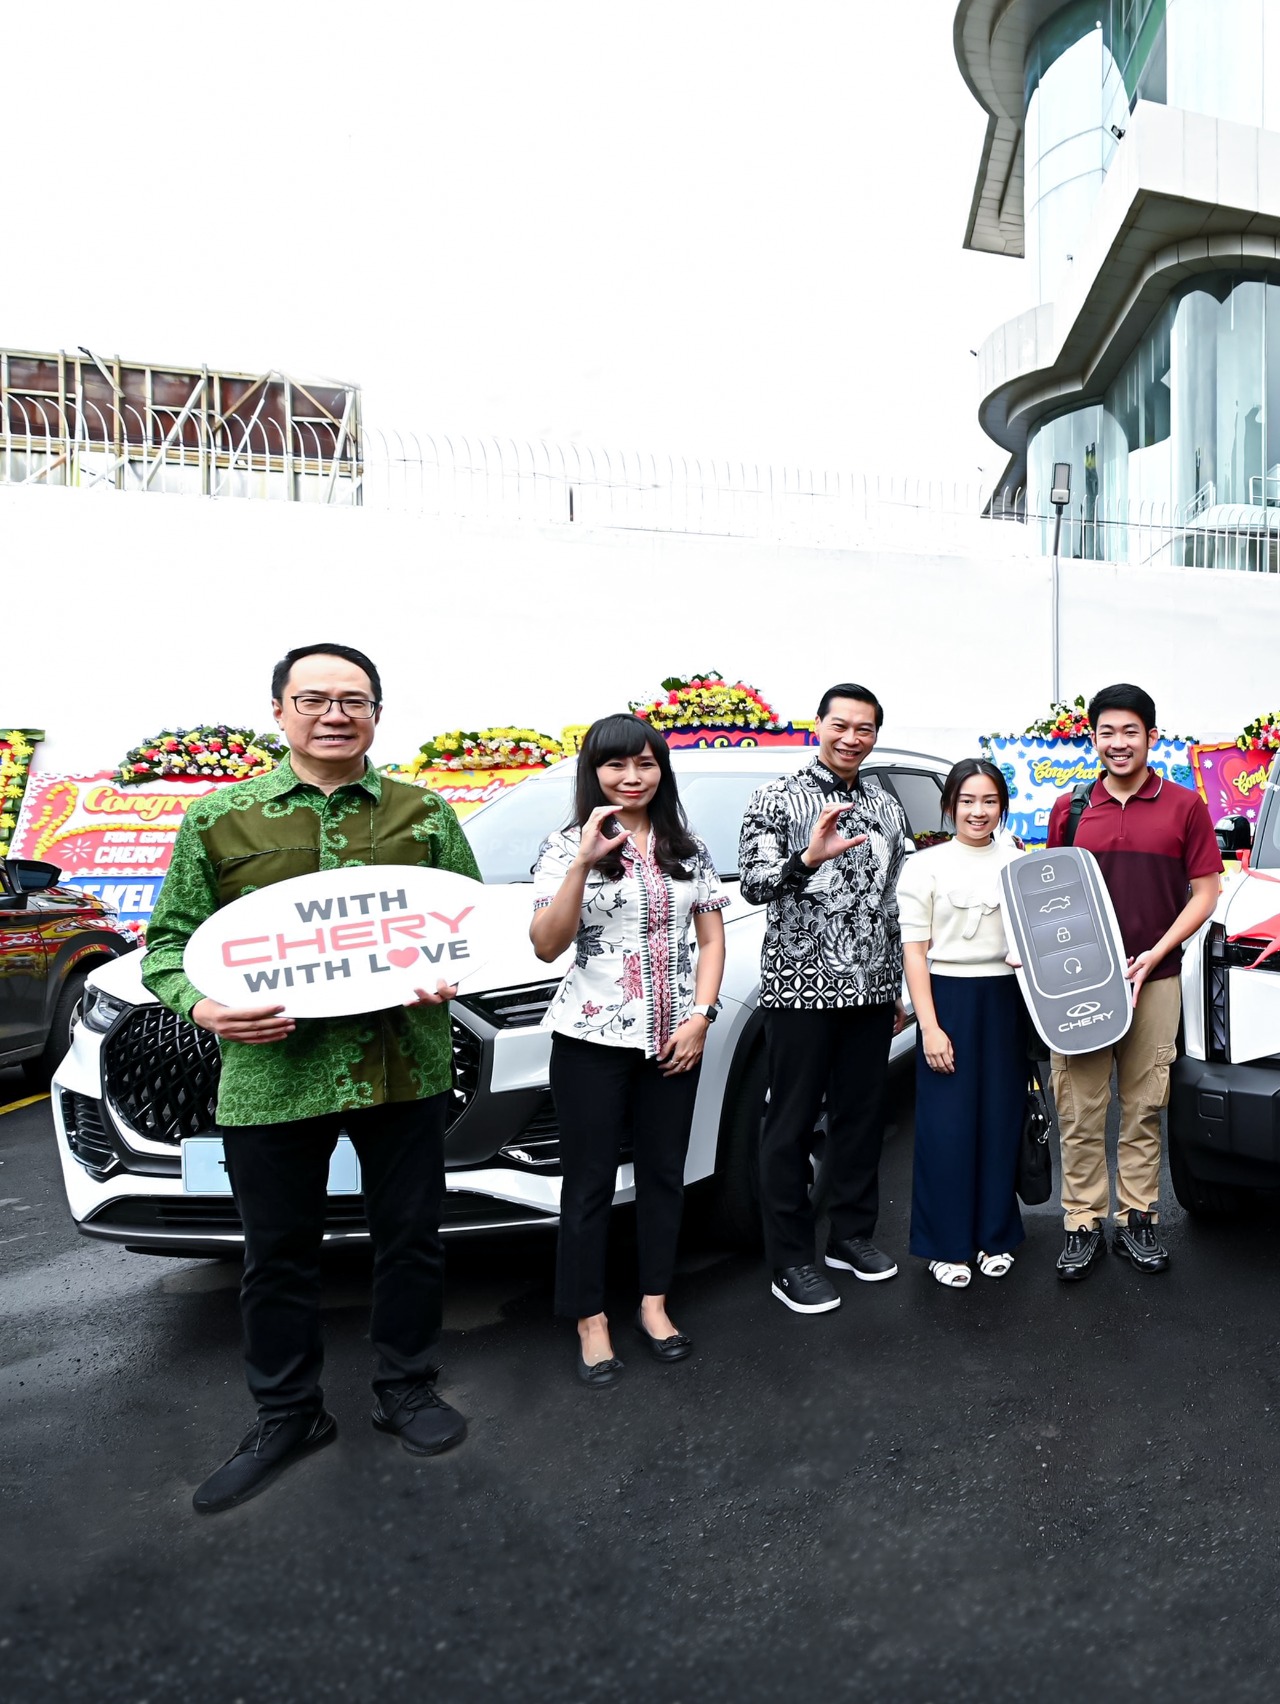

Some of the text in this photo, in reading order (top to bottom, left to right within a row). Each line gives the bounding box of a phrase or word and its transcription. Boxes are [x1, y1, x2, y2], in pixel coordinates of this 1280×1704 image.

[94, 846, 165, 864] CHERY
[294, 888, 408, 924] WITH
[221, 905, 476, 968] CHERY
[243, 957, 351, 993] WITH
[1058, 1010, 1114, 1032] CHERY
